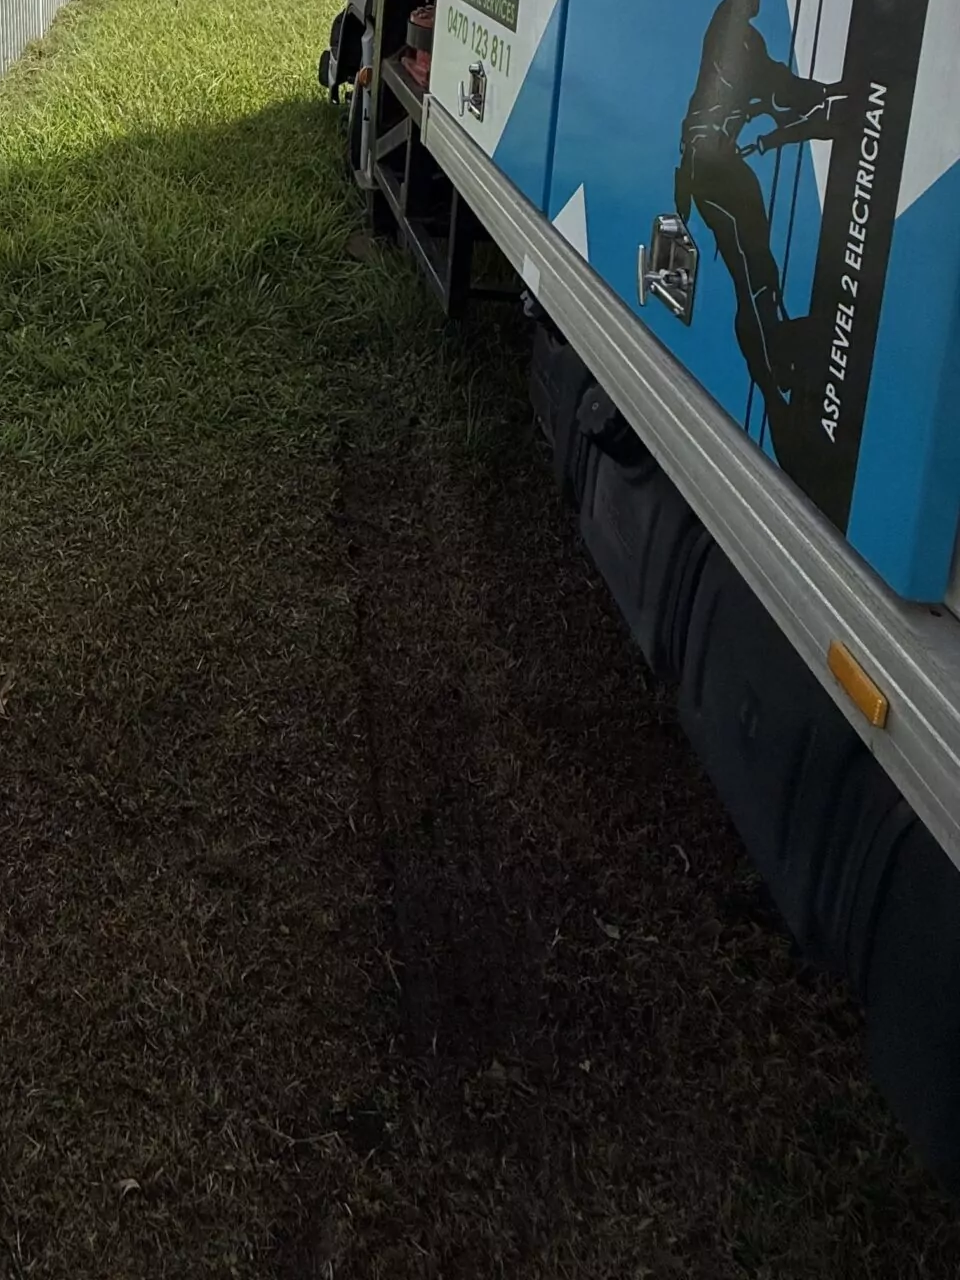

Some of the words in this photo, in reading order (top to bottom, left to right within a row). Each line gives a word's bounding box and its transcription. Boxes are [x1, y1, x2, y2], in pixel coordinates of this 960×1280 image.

[448, 6, 468, 45] 0470
[471, 21, 488, 60] 123
[491, 35, 511, 77] 811
[844, 82, 888, 270] ELECTRICIAN
[841, 275, 858, 298] 2
[829, 303, 855, 381] LEVEL
[821, 383, 841, 443] ASP
